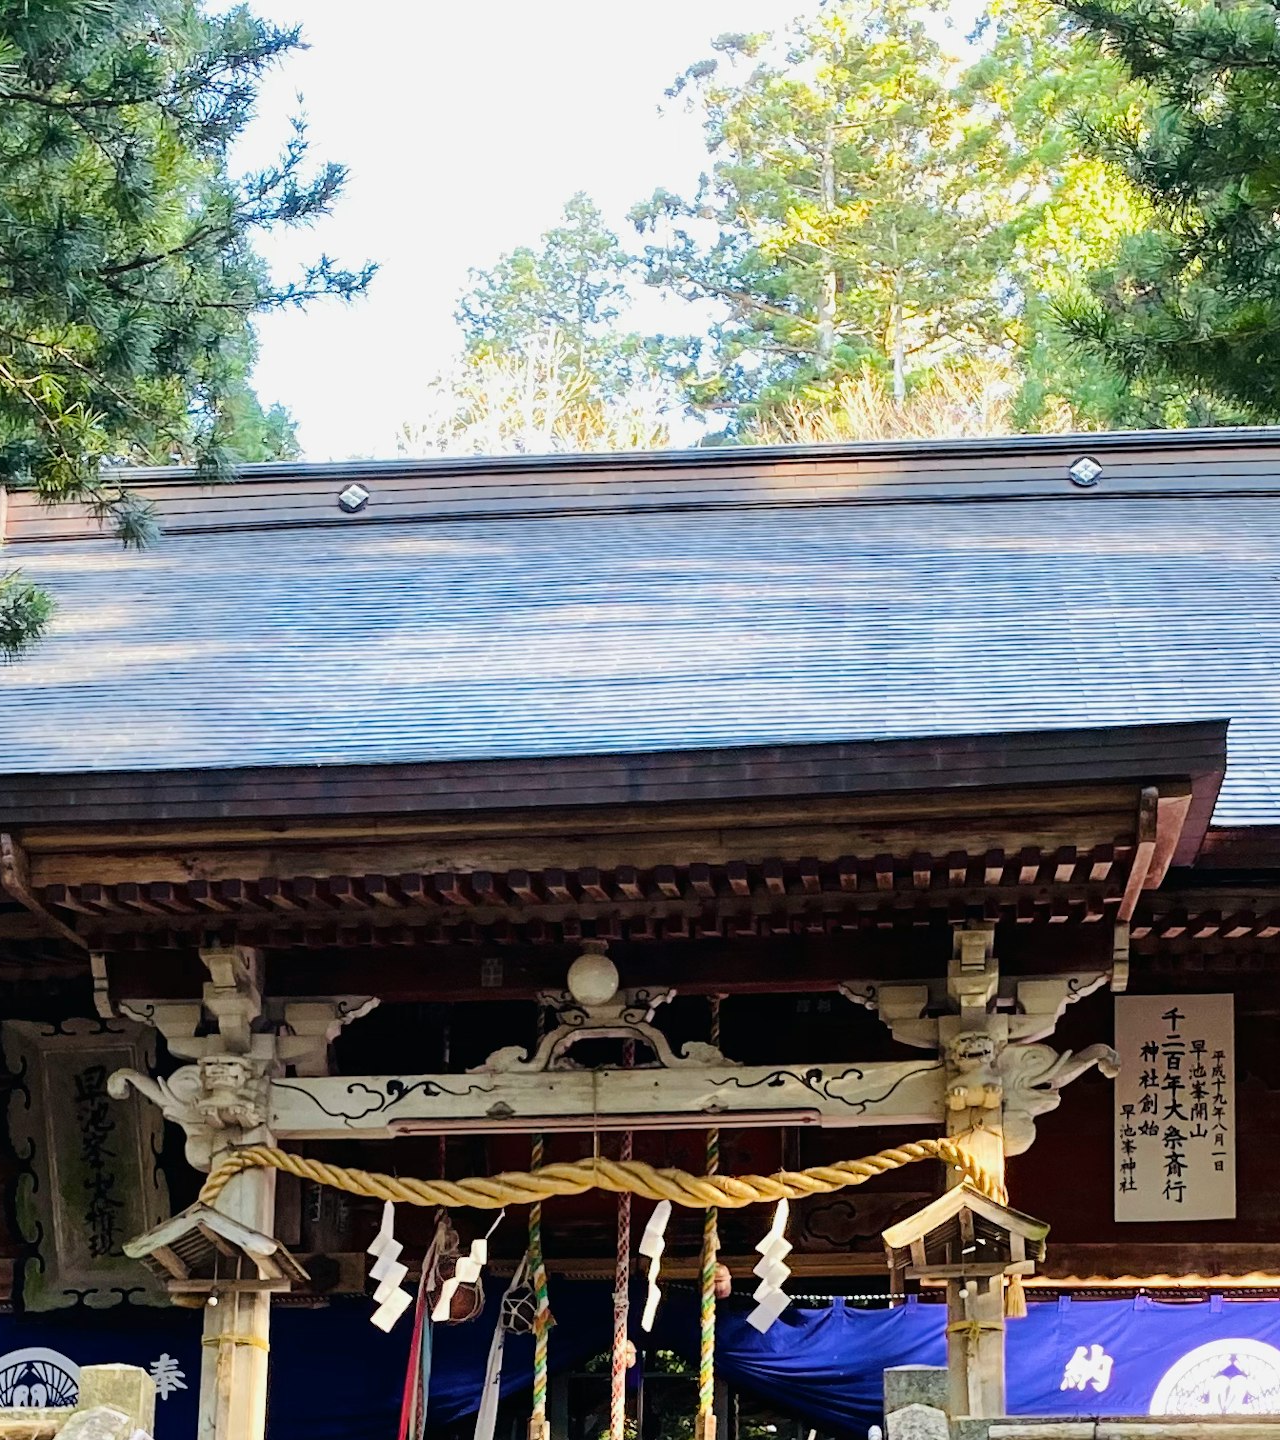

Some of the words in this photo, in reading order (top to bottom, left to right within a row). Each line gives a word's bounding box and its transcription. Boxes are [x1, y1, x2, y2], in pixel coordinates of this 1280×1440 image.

[1137, 1040, 1160, 1137] 神社創始
[1161, 1006, 1189, 1203] 千二百年大祭斎行
[1210, 1050, 1229, 1173] 平成十九年八月一日
[1119, 1103, 1138, 1193] 早池峯神社
[149, 1352, 189, 1401] 奉
[1060, 1343, 1114, 1393] 納
